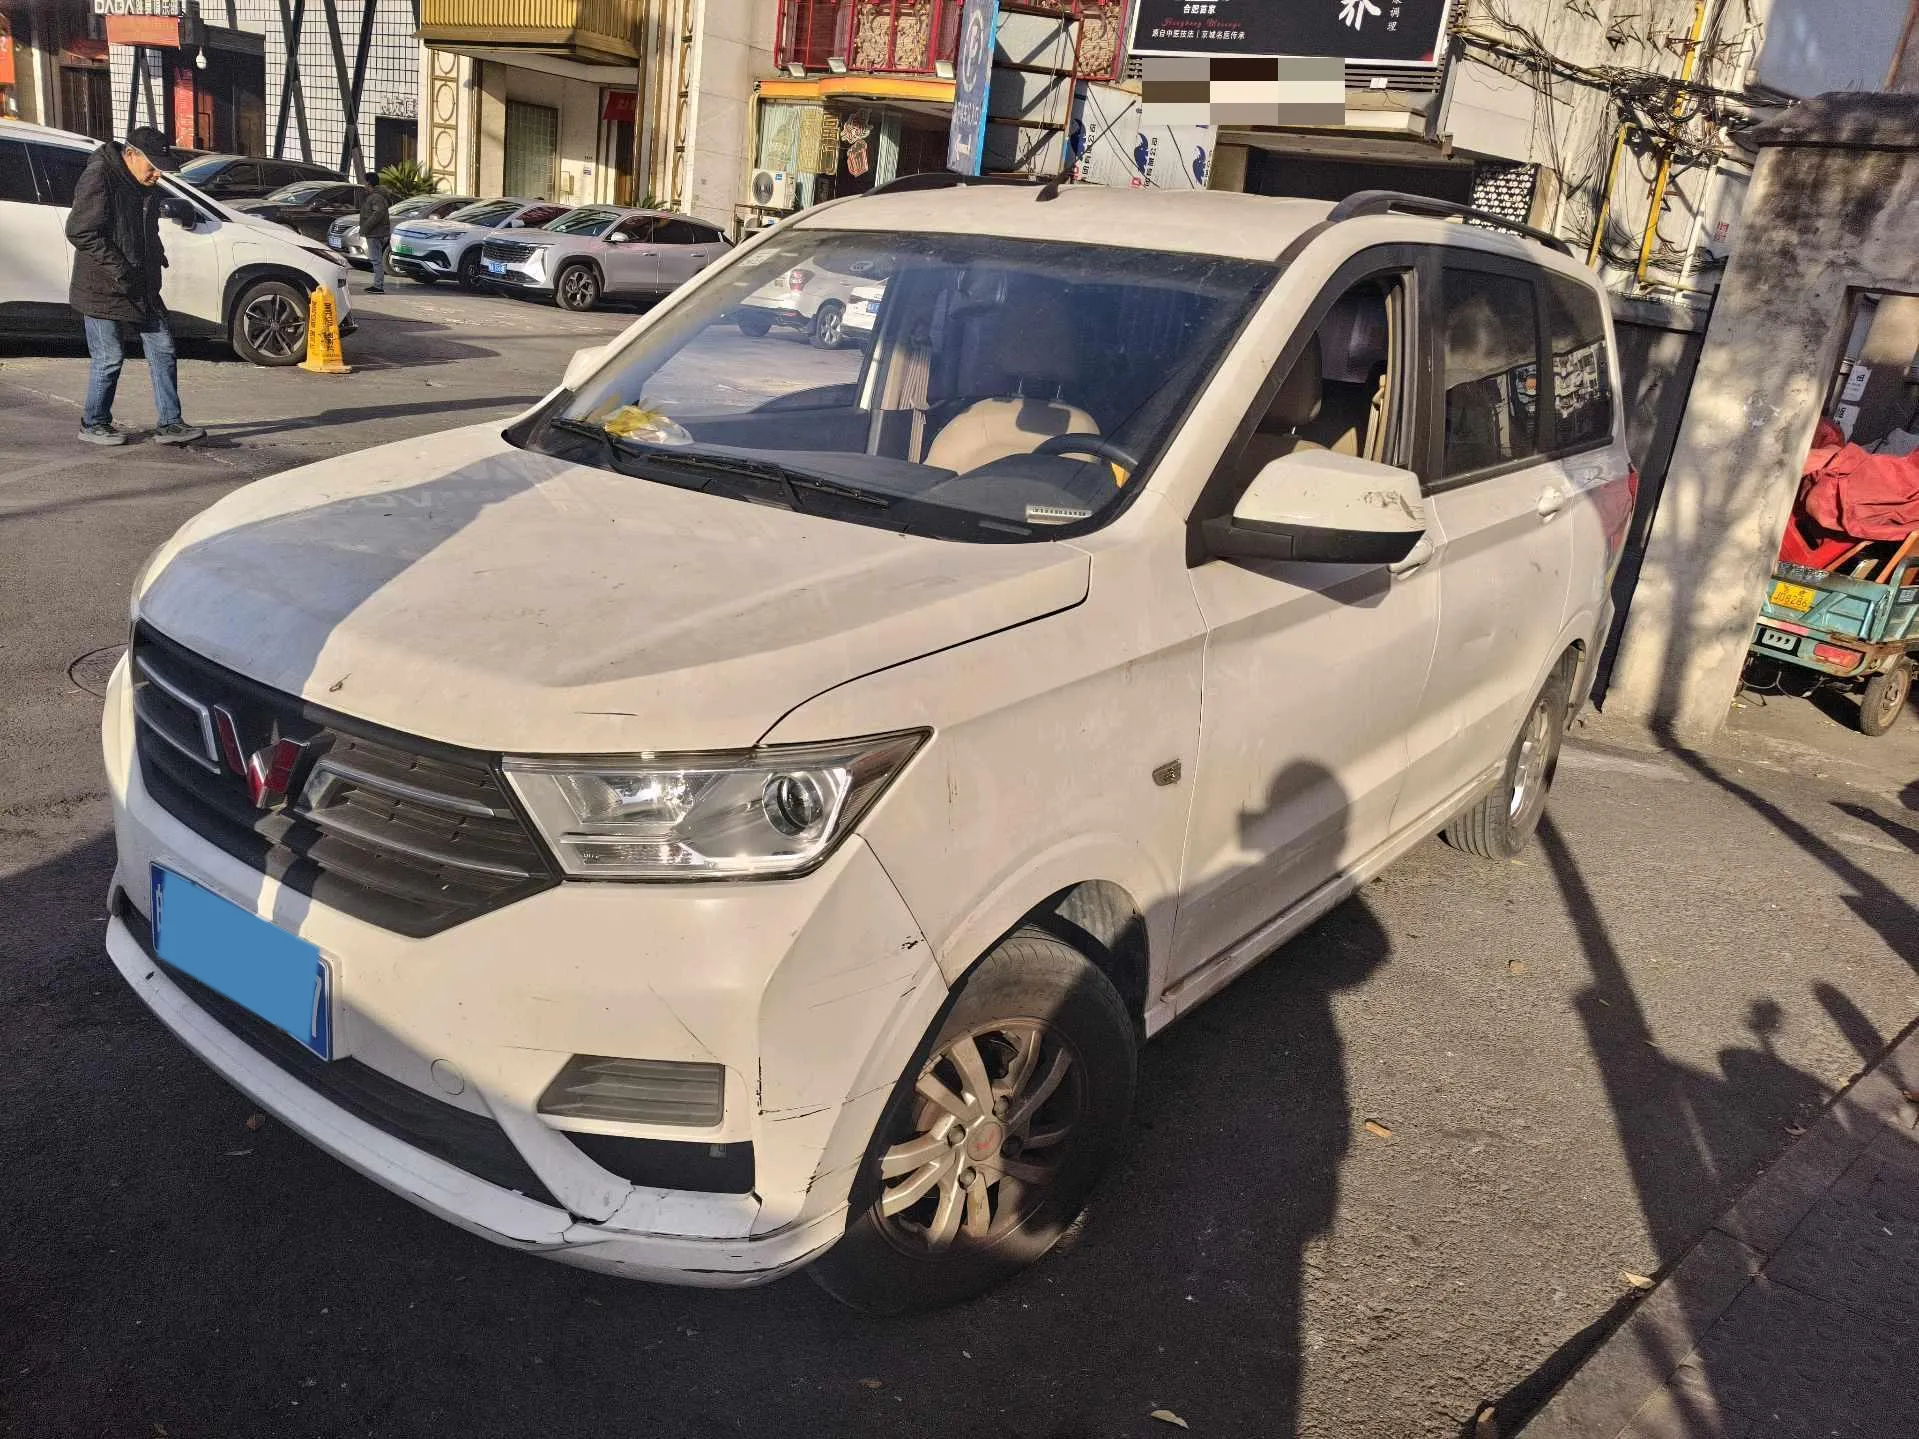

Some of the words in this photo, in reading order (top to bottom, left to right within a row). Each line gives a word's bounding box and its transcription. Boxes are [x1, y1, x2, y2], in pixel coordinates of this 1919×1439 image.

[1183, 4, 1217, 15] 合肥首家
[1151, 28, 1194, 39] 源自中医技法
[1201, 30, 1246, 40] 京城名医传承
